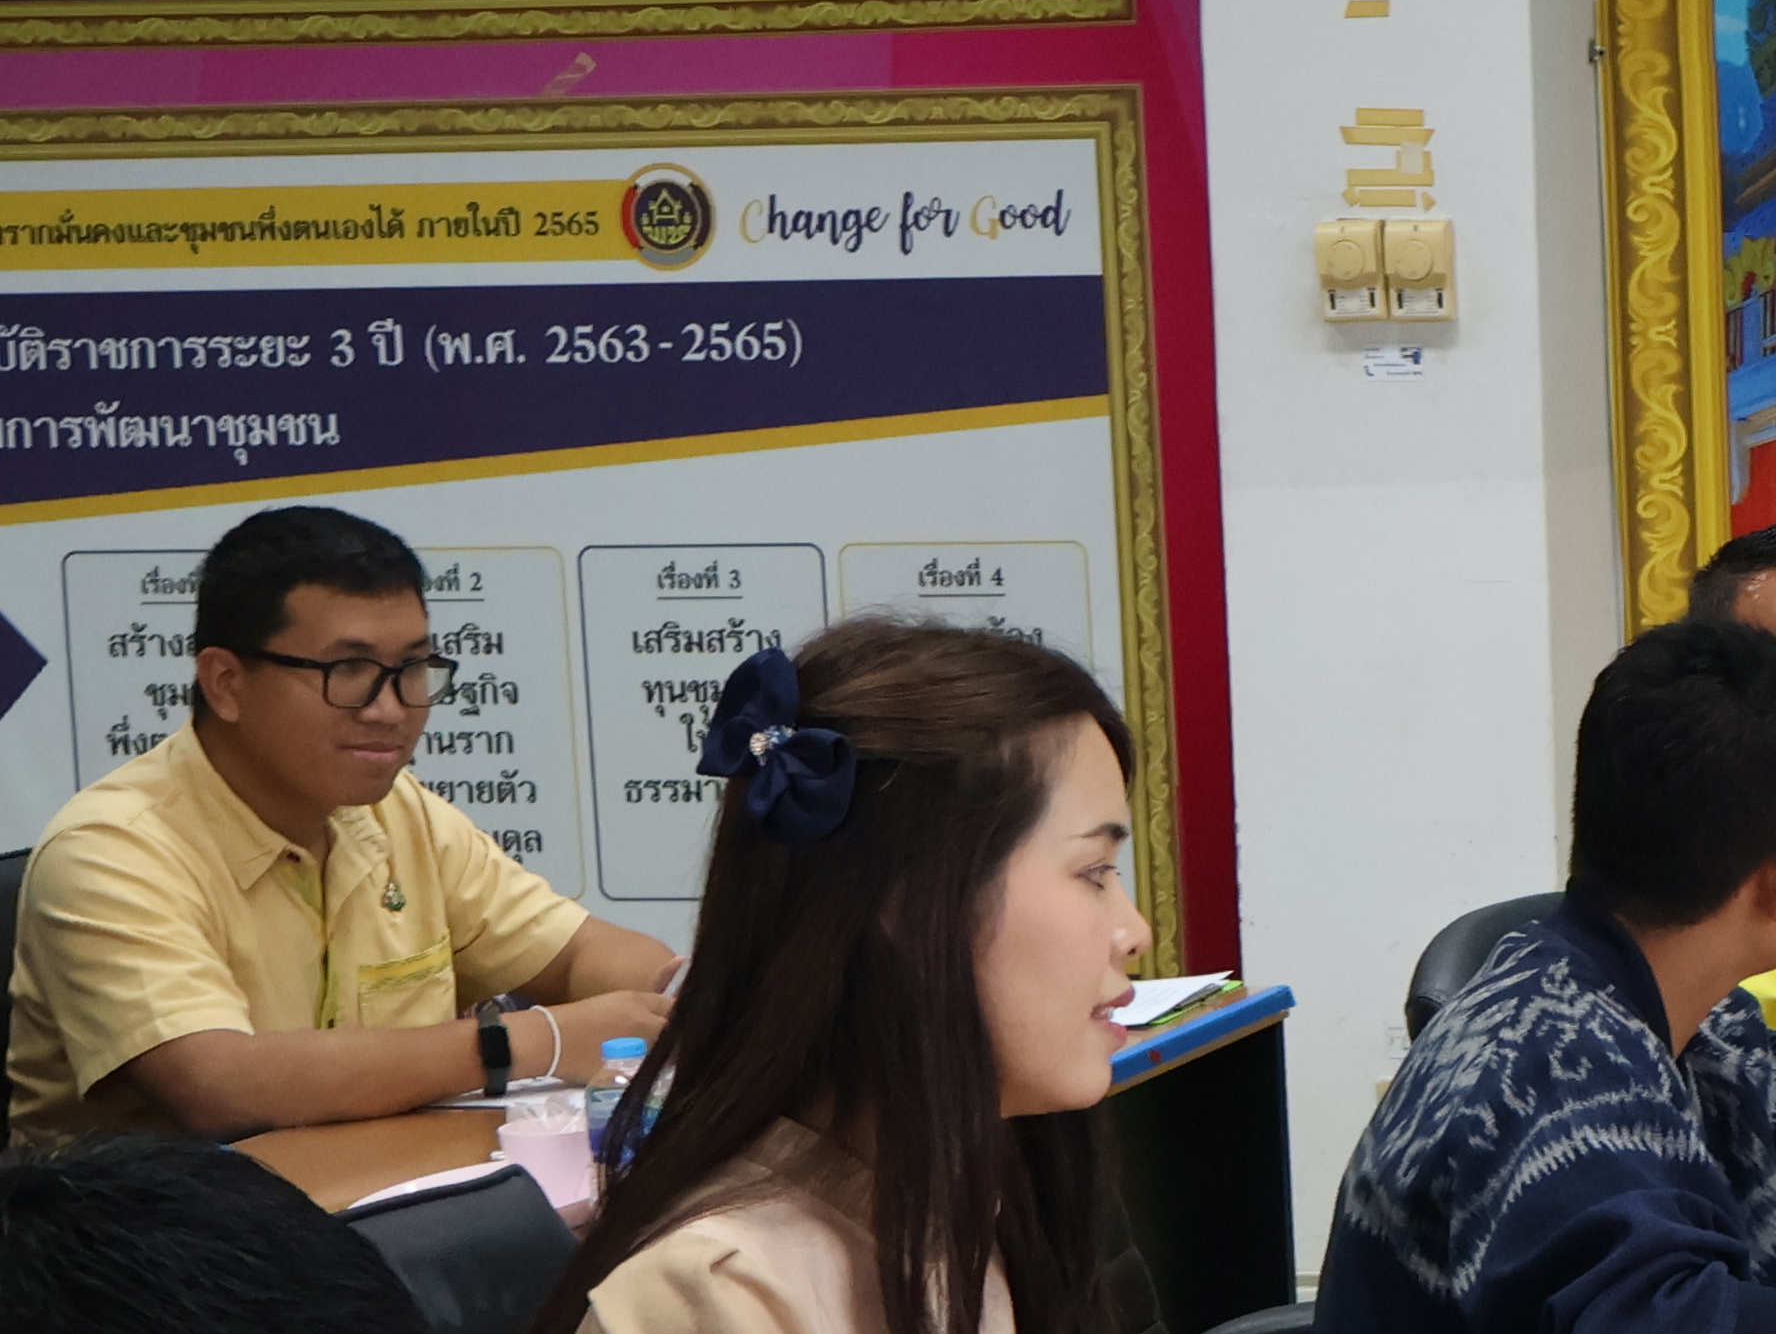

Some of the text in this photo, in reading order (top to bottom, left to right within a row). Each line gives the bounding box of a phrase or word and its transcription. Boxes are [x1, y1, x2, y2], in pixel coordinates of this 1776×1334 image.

[0, 199, 601, 255] รากมั่นคงและชุมชนพึ่งตนเองได้ ภายในปี 2565
[739, 188, 1072, 255] Change for Good
[329, 329, 355, 368] 3
[372, 316, 405, 368] ปี
[424, 324, 526, 373] (พ.ศ.
[469, 573, 483, 592] 2
[657, 560, 742, 590] เรื่องที่ 3
[918, 557, 1005, 587] เรื่องที่ 4
[632, 617, 782, 654] เสริมสร้าง
